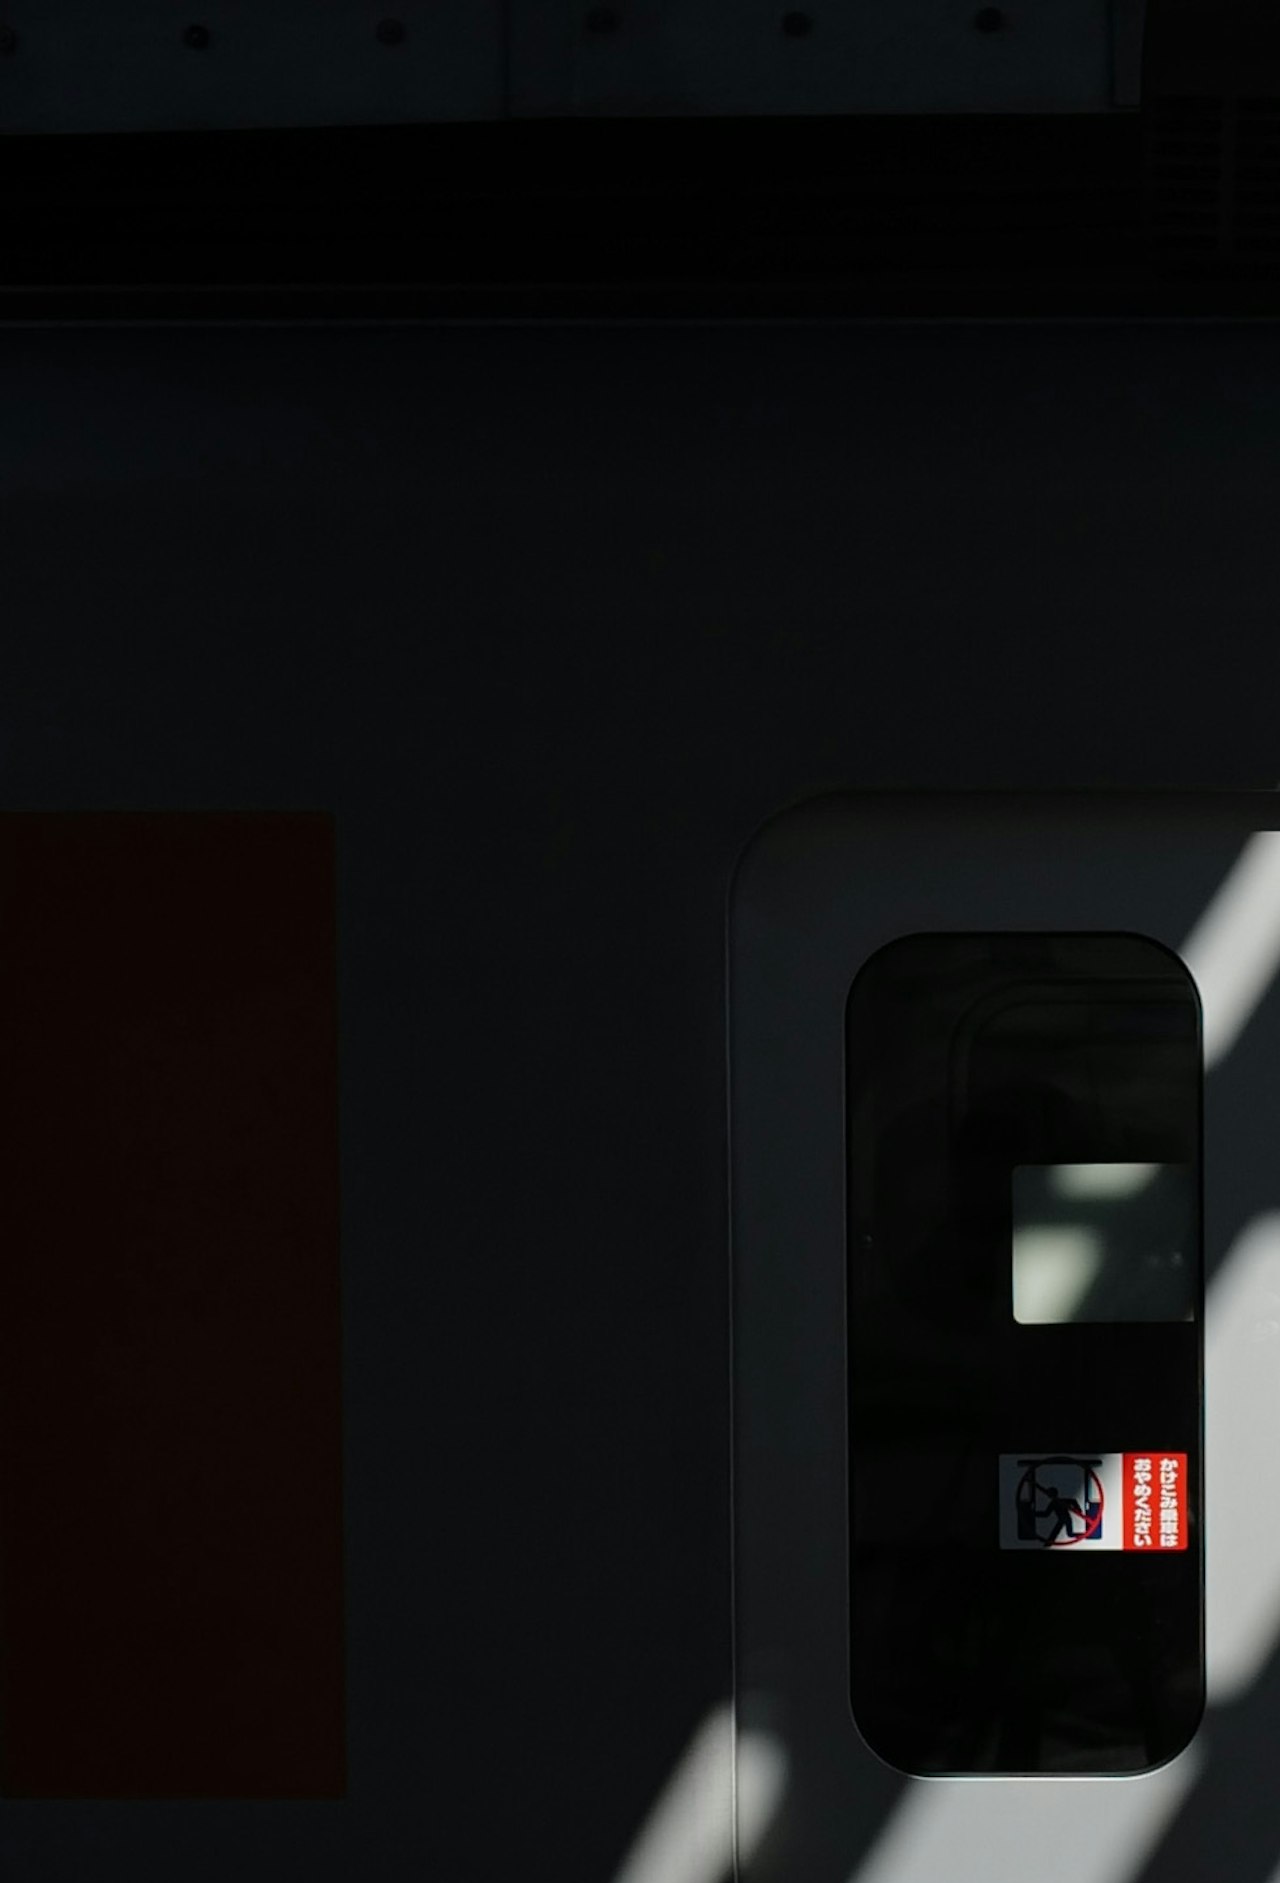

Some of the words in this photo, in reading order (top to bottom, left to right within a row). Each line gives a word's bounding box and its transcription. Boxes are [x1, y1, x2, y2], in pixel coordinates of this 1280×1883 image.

[1134, 1458, 1153, 1547] おやめください
